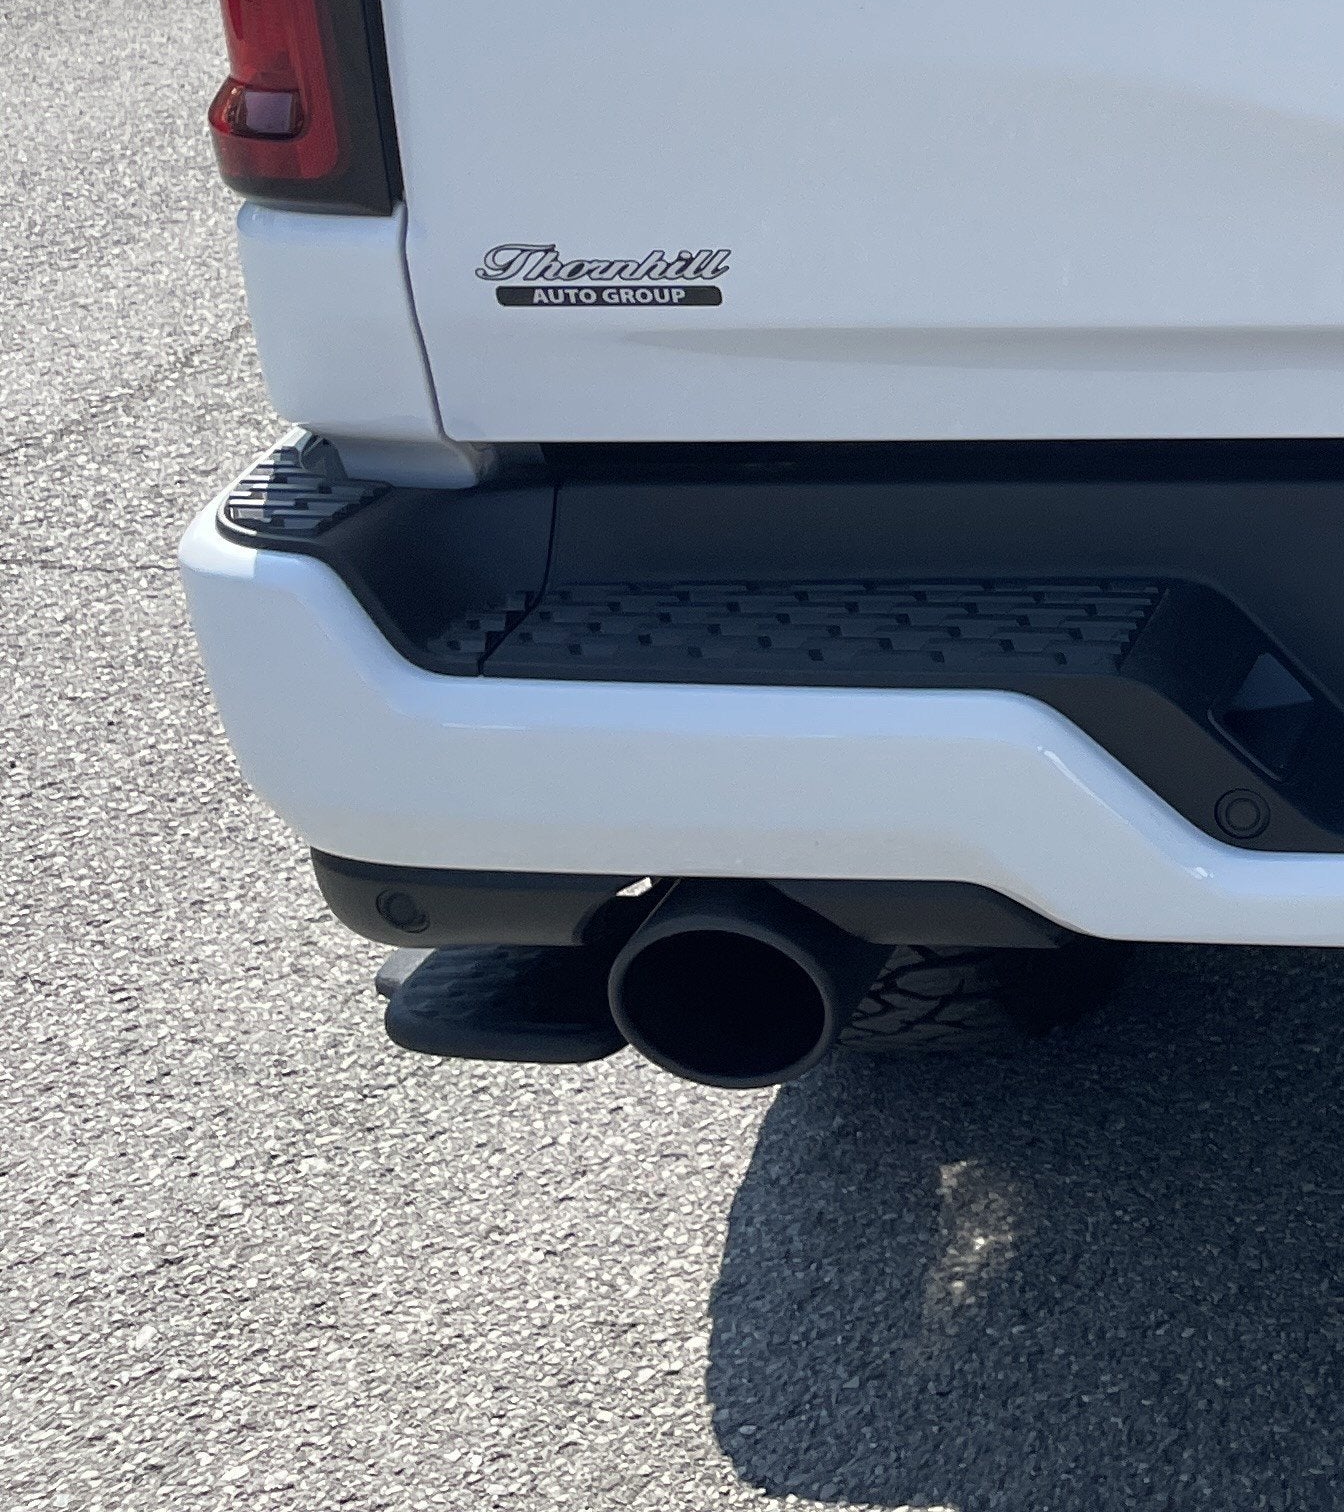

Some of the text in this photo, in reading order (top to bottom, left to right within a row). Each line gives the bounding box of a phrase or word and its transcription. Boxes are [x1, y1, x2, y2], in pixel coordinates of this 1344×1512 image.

[475, 243, 732, 281] Thornhill
[531, 288, 687, 305] AUTO GROUP
